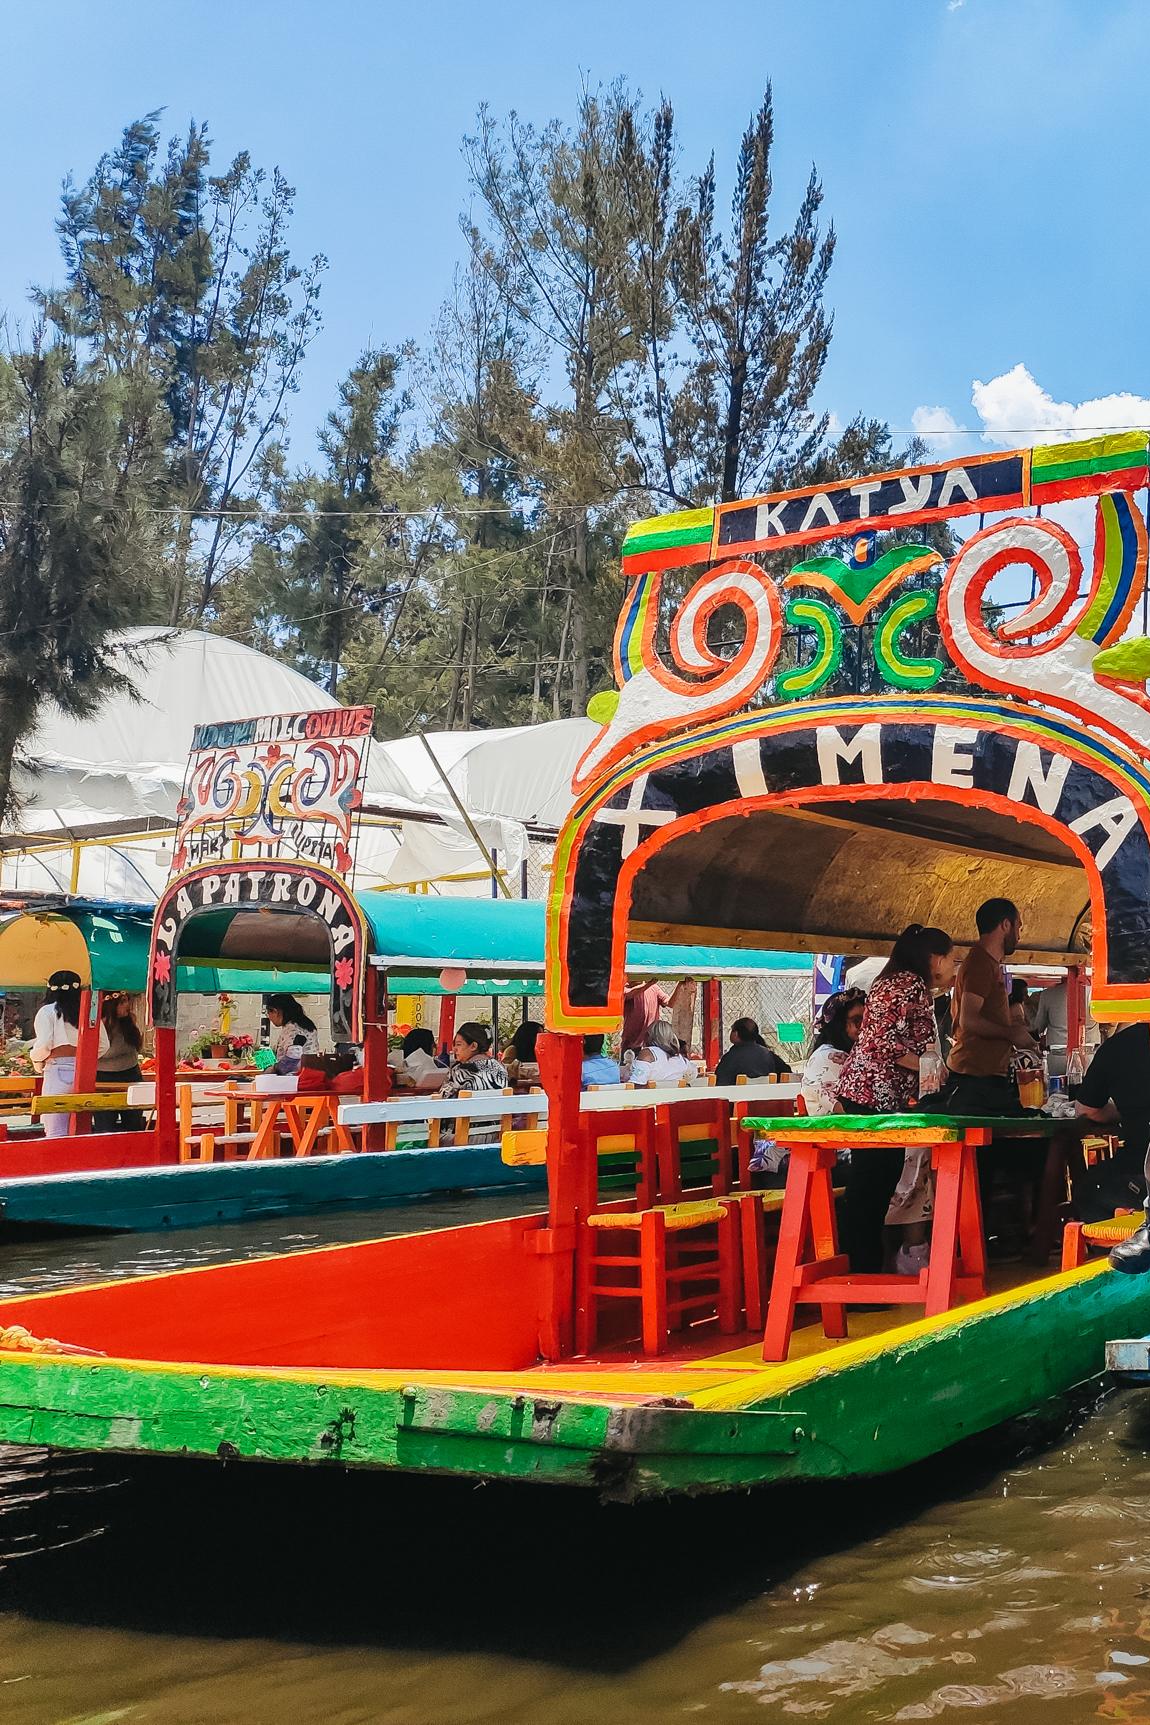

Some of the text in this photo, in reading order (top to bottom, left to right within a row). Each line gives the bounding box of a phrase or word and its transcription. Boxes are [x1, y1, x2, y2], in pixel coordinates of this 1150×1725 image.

[754, 466, 978, 542] KATYA
[595, 722, 1141, 871] XIMENA
[202, 871, 355, 954] PATRONA
